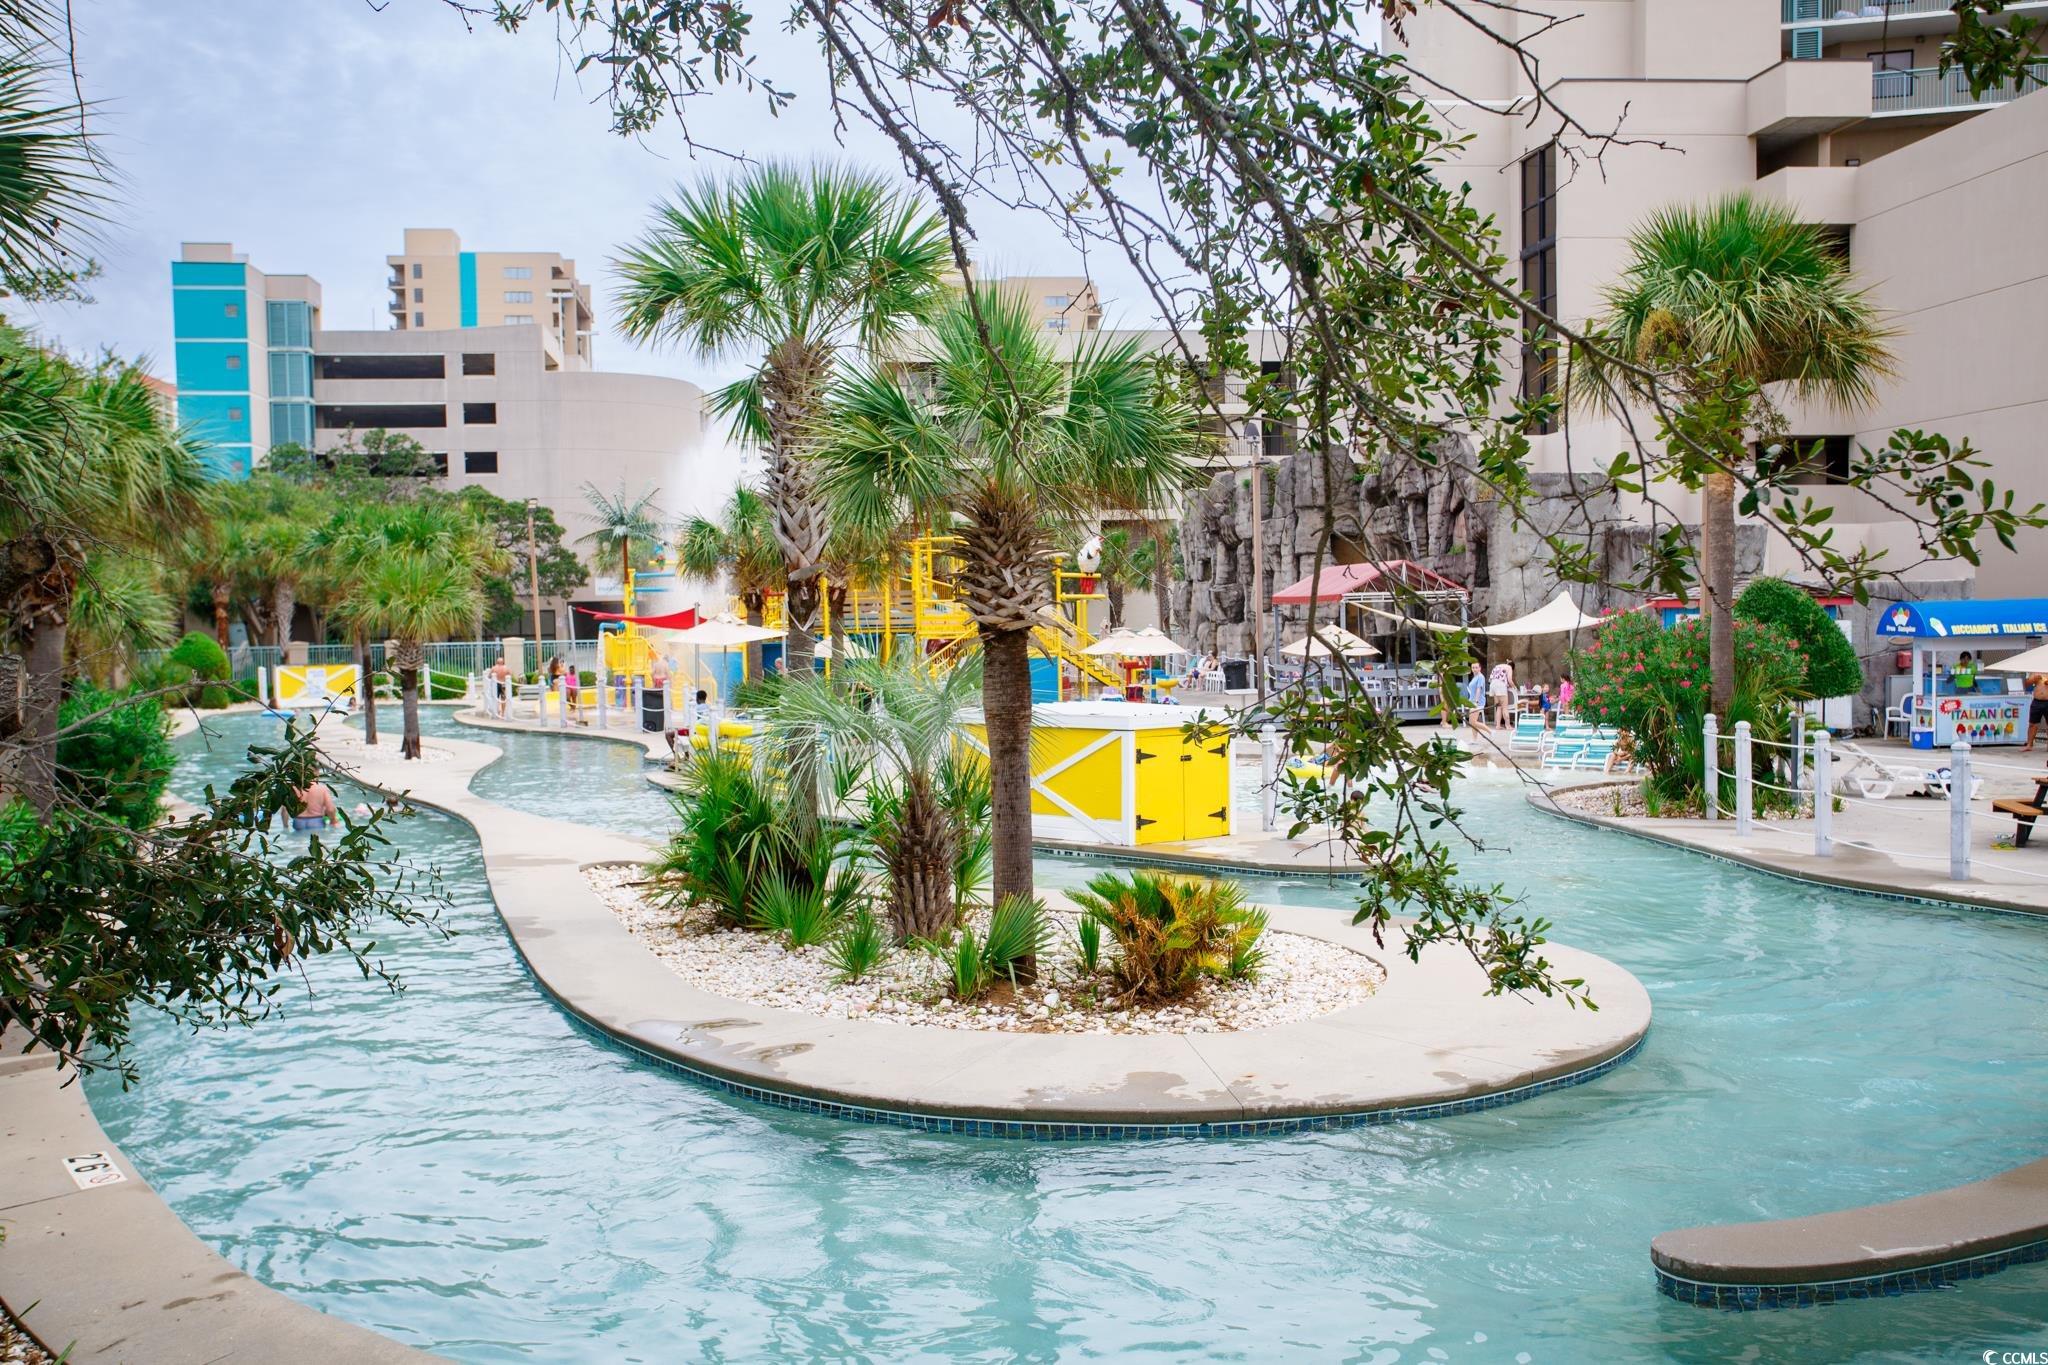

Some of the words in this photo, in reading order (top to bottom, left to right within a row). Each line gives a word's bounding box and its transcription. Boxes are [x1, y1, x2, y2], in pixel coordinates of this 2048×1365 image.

[2002, 623, 2033, 633] ITALIAN
[2033, 622, 2048, 633] ICE
[1951, 709, 1997, 721] ITALIAN
[1999, 708, 2020, 719] ICE
